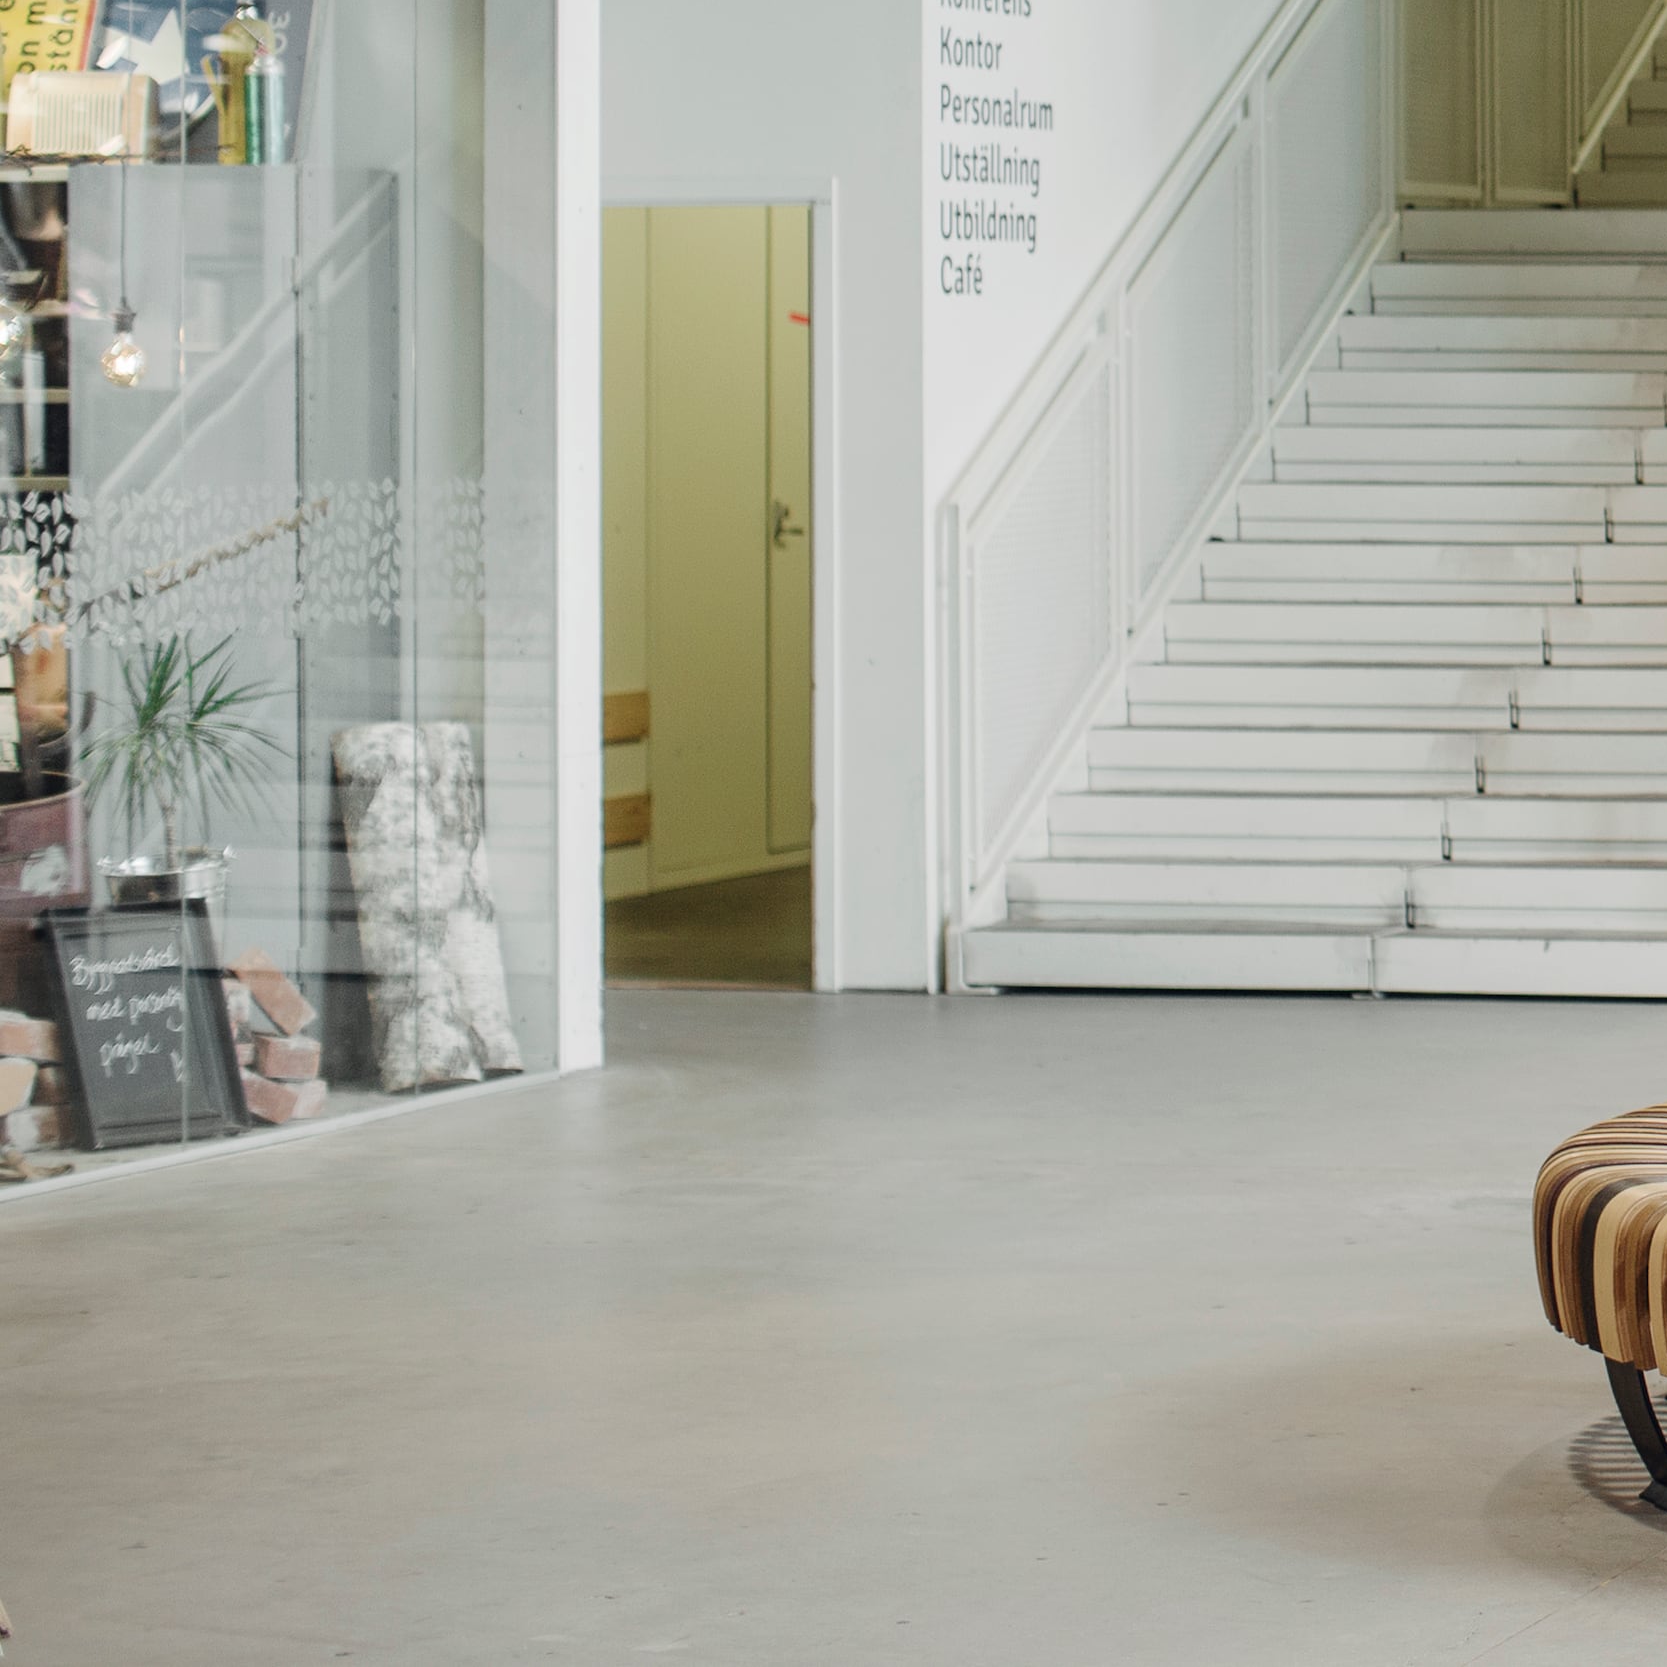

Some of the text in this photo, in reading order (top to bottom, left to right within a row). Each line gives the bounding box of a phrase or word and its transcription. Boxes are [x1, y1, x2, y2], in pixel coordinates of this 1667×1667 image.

[940, 26, 1002, 71] Kontor
[940, 83, 1053, 131] Personalrum
[940, 142, 1040, 198] Utställning
[940, 199, 1037, 254] Utbildning
[940, 253, 983, 296] Café
